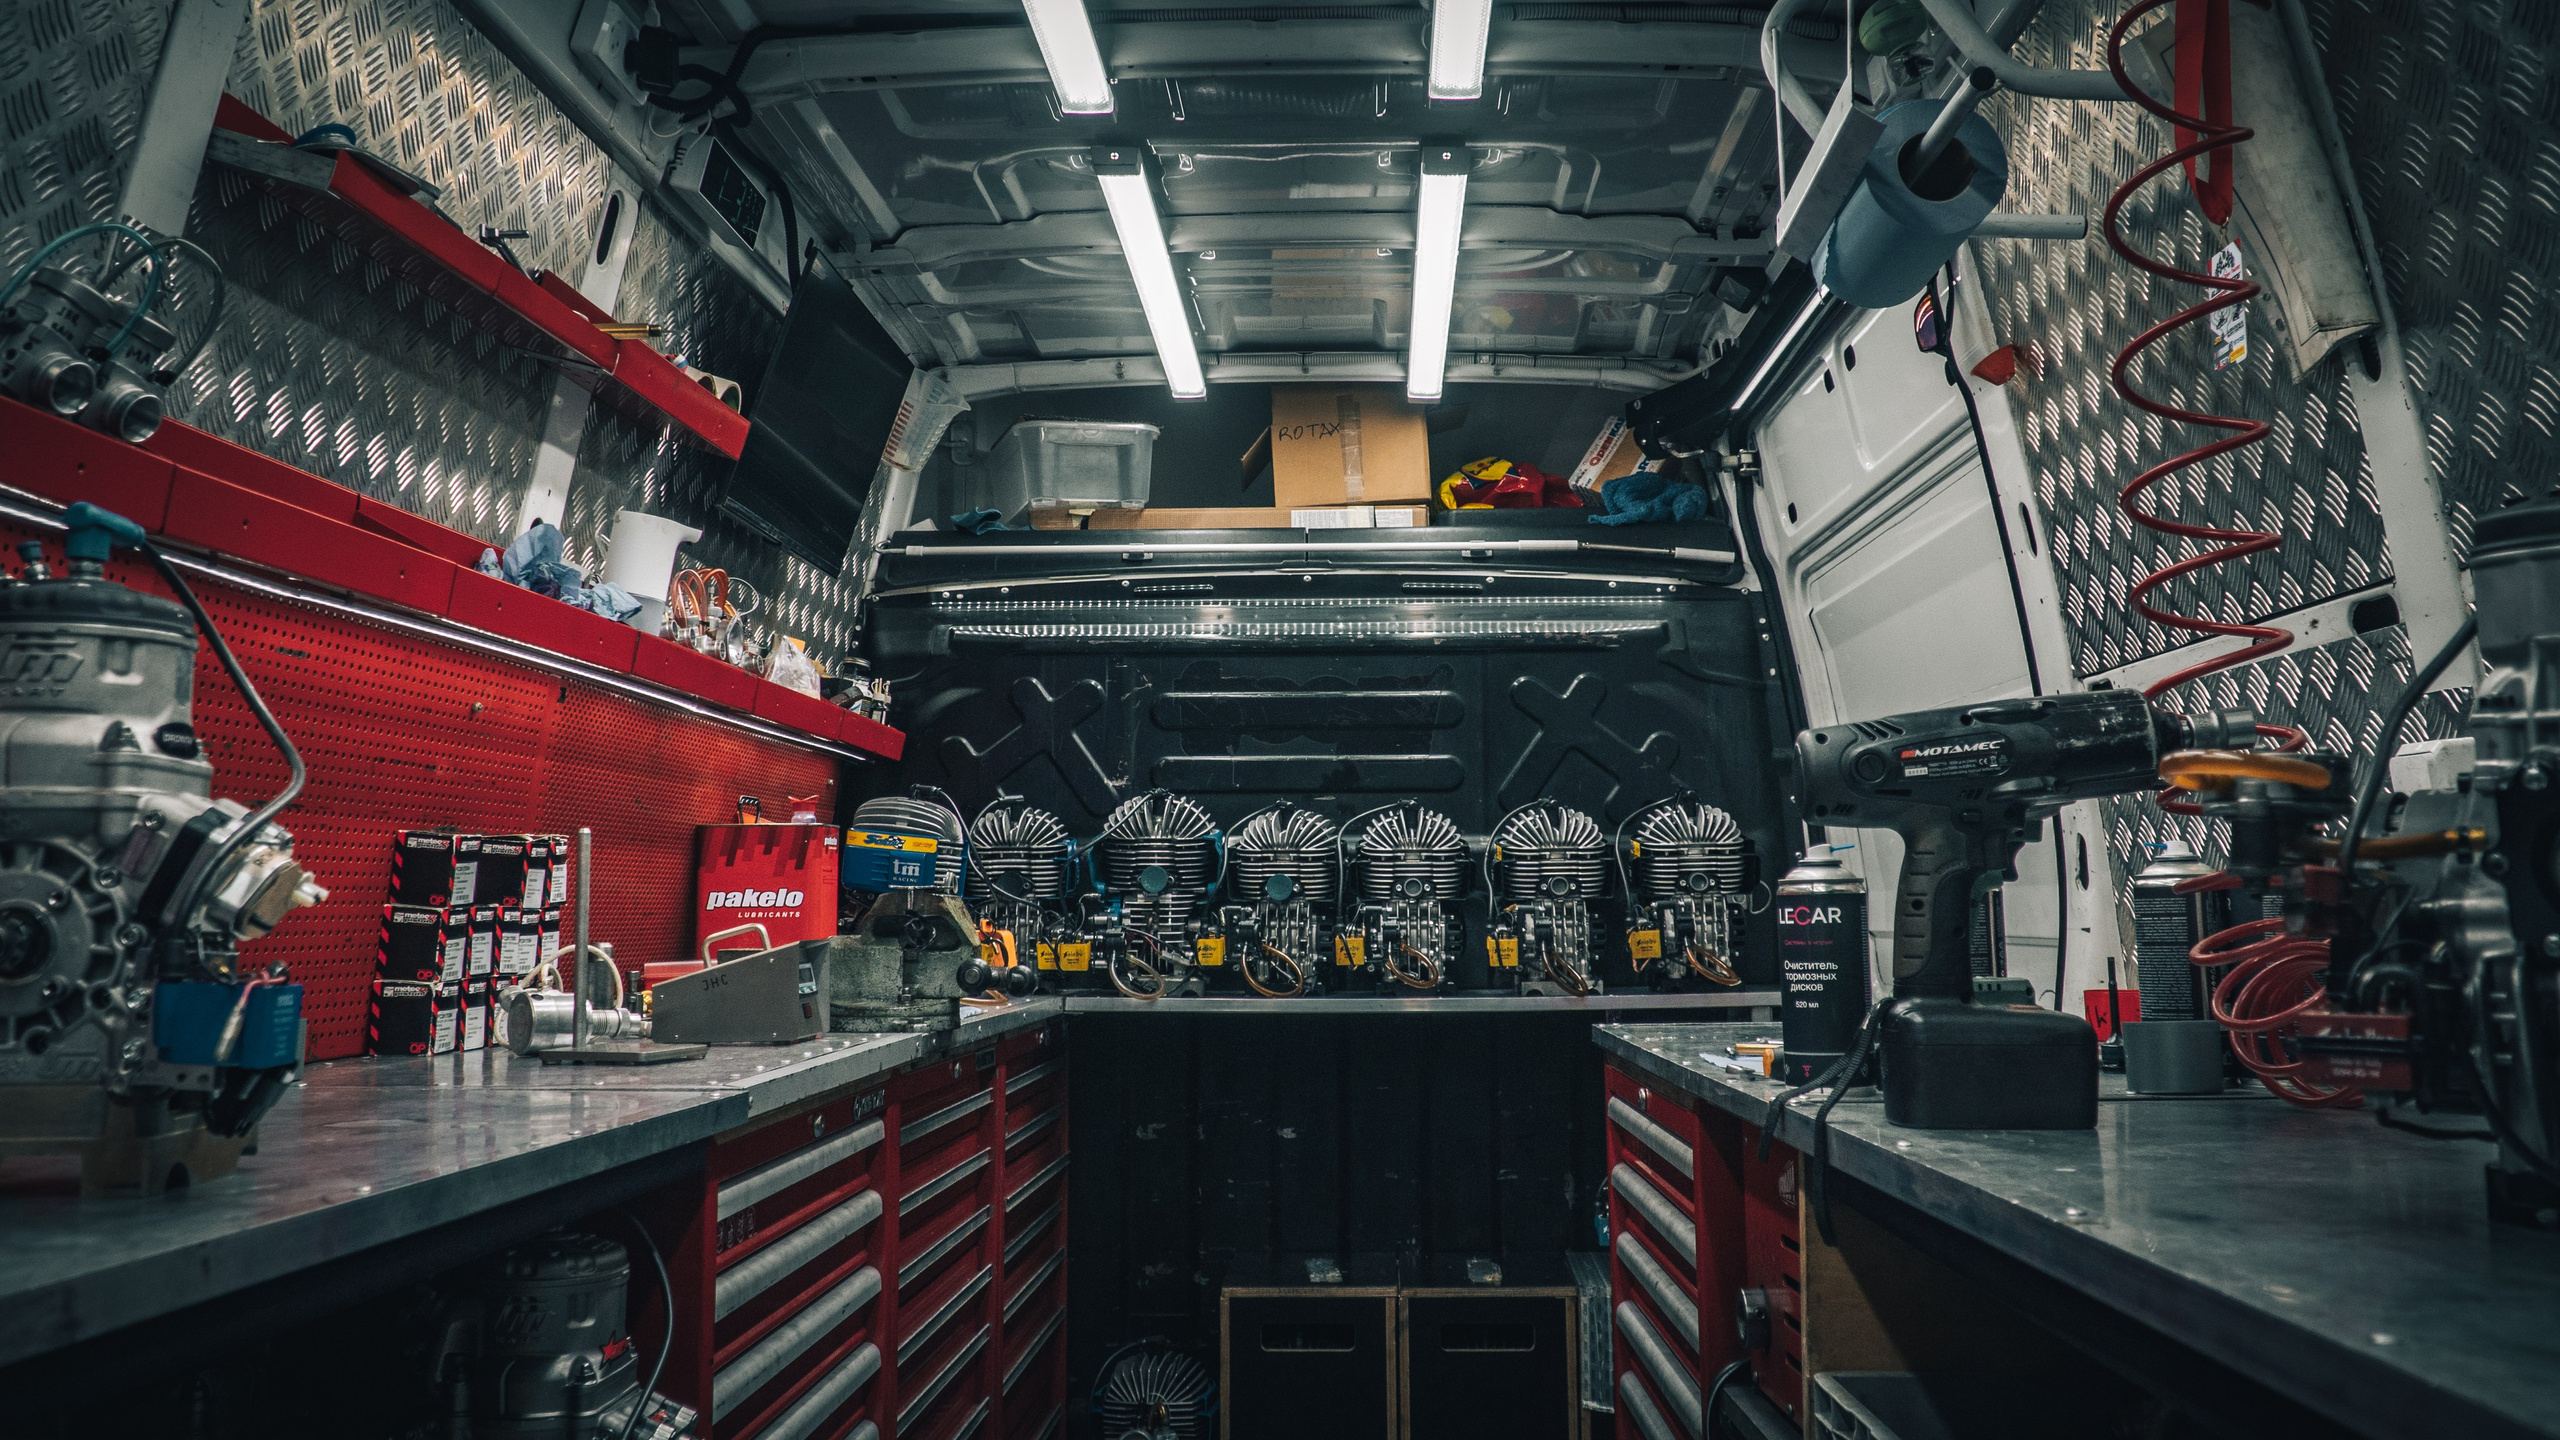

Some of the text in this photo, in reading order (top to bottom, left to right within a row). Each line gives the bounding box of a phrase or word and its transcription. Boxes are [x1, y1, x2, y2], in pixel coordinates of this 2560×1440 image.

[1278, 422, 1341, 441] ROTAX
[1914, 740, 2002, 757] MOTAMEC
[893, 859, 921, 876] tm
[706, 888, 804, 910] pakelo
[1779, 906, 1842, 926] LECAR
[1784, 960, 1838, 970] Очиститель
[1786, 972, 1837, 982] тормозных
[1790, 983, 1824, 992] дисков
